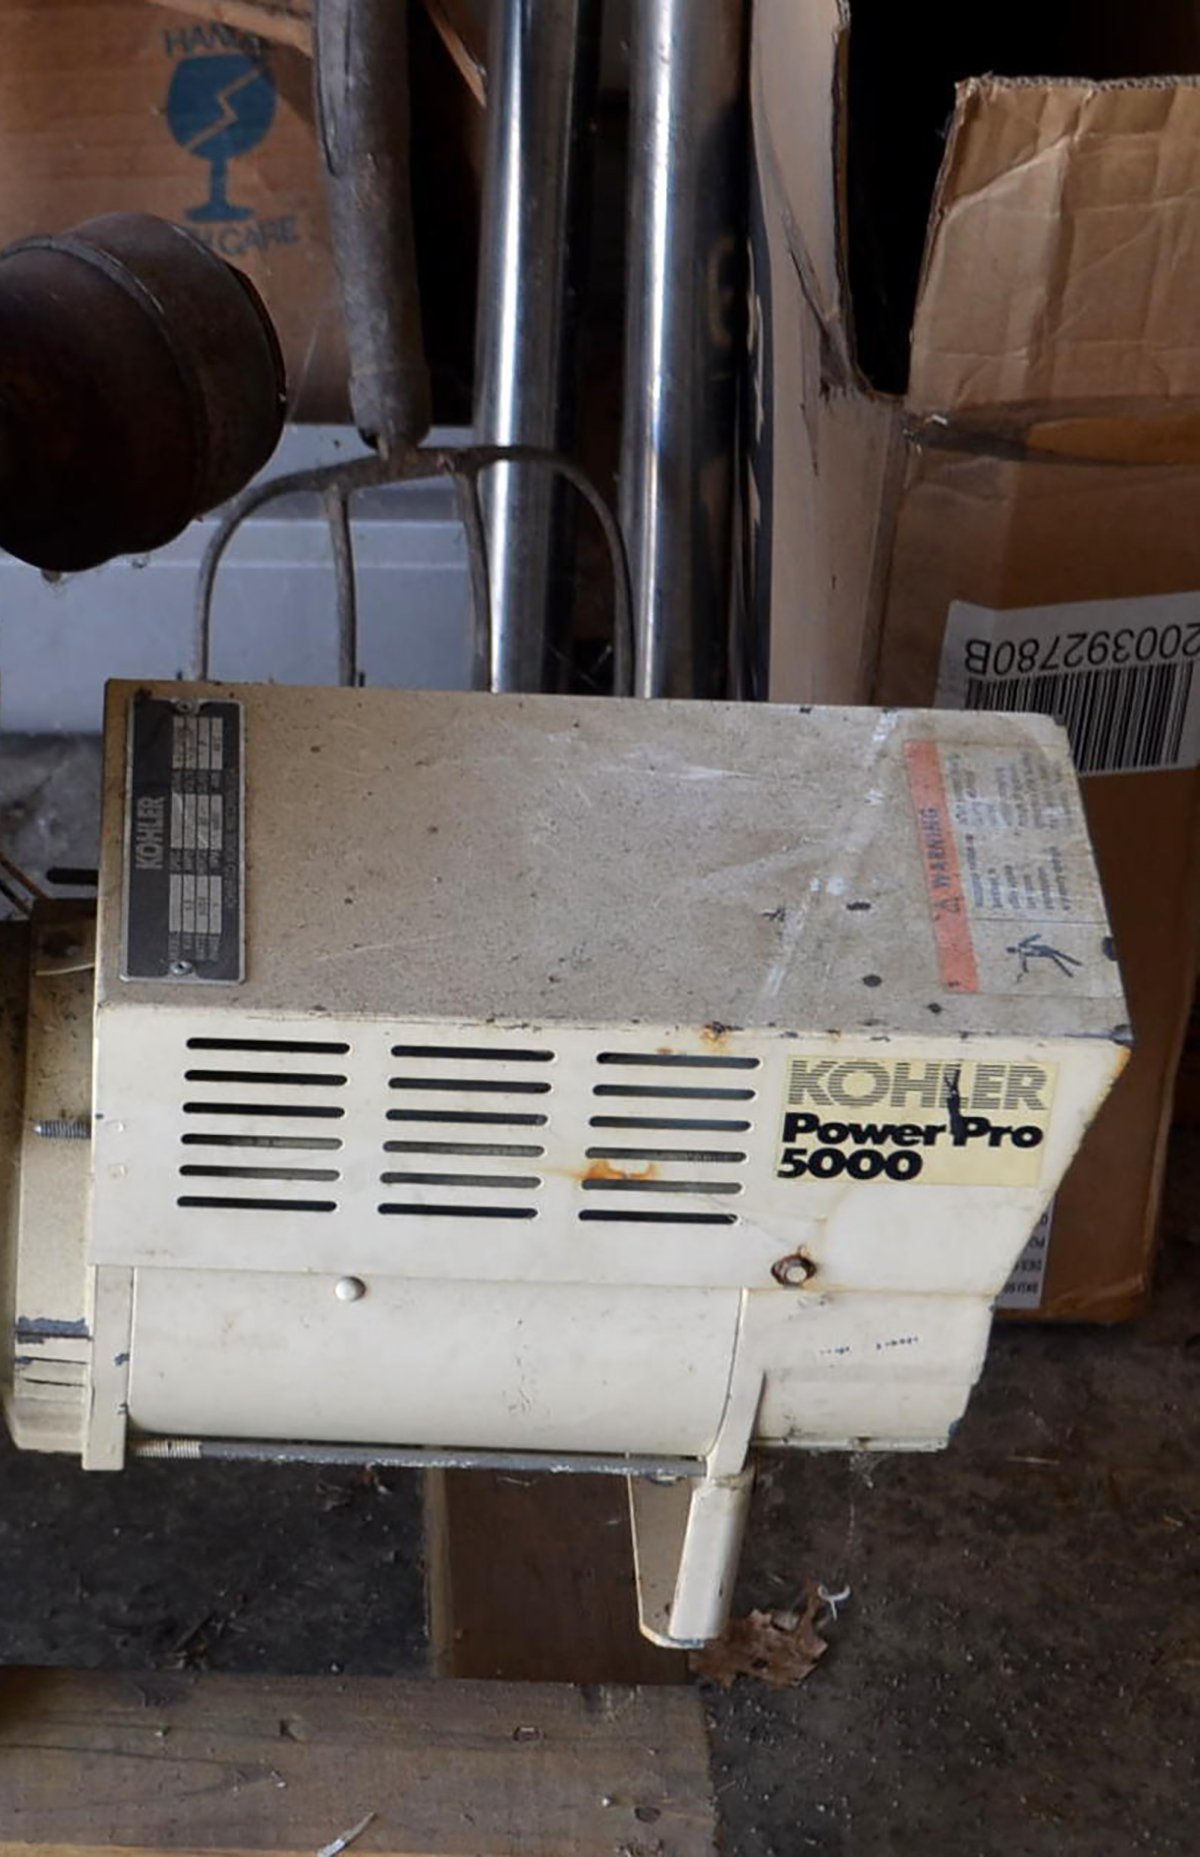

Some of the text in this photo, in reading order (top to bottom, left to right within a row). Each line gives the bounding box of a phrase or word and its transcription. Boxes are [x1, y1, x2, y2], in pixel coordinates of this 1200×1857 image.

[964, 622, 1200, 676] 200392780B
[135, 796, 165, 870] KOHLER
[918, 807, 951, 889] WARNING
[787, 1059, 1048, 1111] KOHLER
[776, 1147, 923, 1181] 5000
